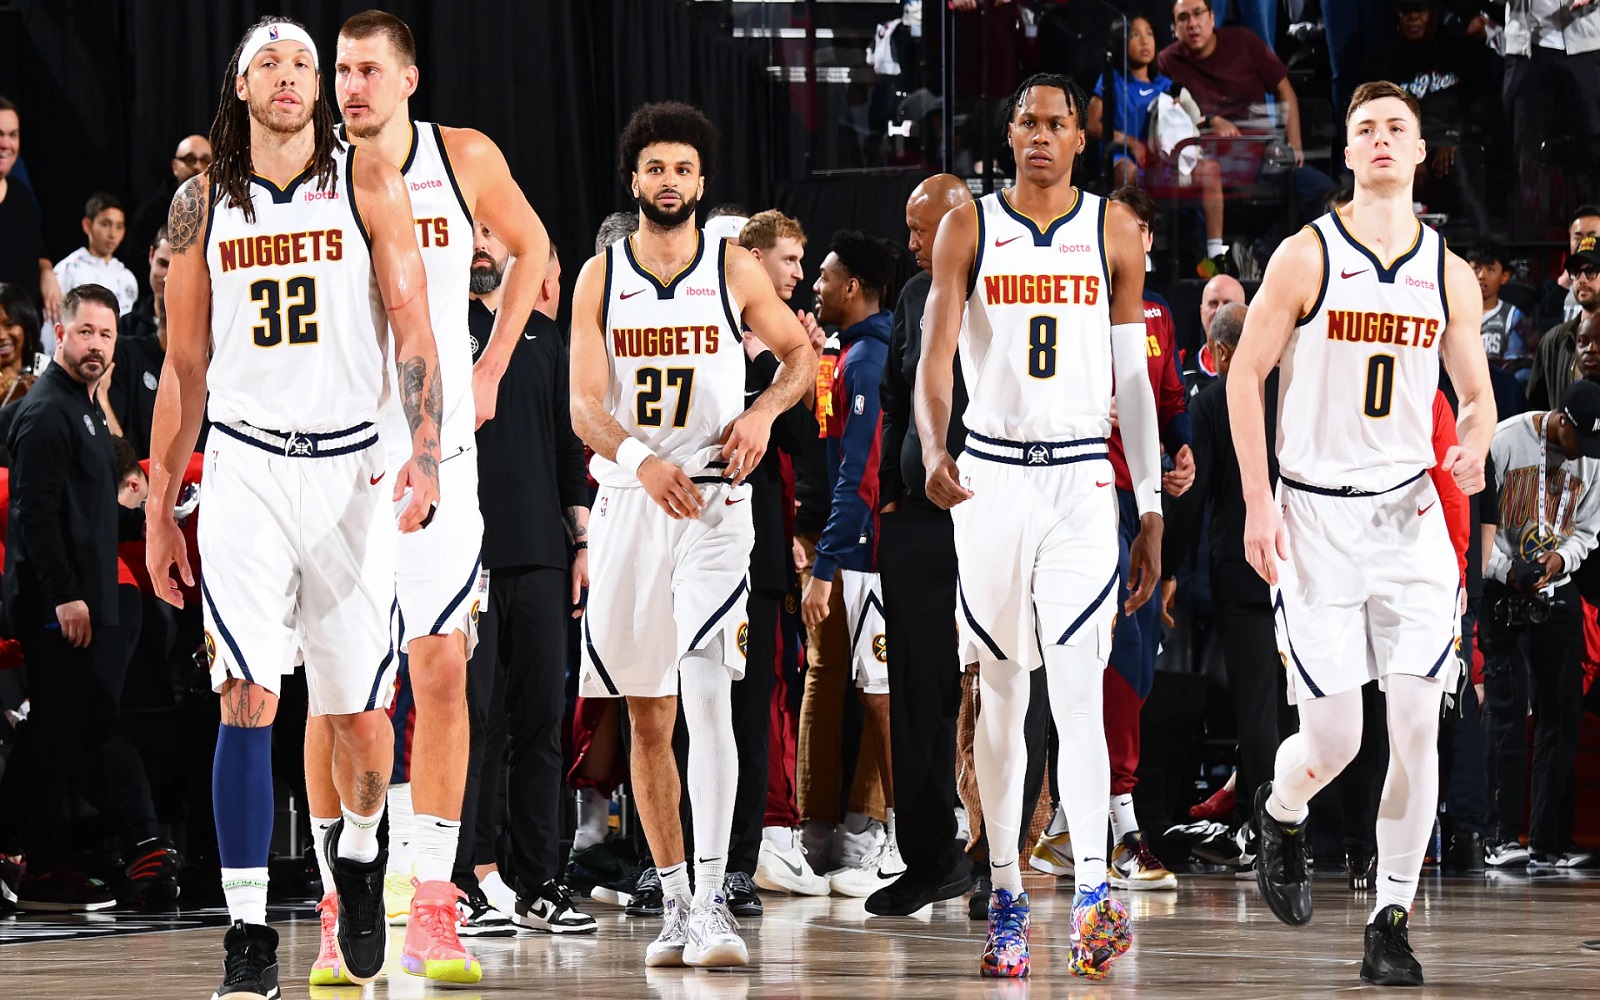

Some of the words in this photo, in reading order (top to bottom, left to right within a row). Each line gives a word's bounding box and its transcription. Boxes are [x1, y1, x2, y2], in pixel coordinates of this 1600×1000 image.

[410, 179, 443, 191] ibotta
[218, 229, 343, 273] NUGGETS
[1058, 243, 1091, 253] ibotta
[686, 286, 716, 296] ibotta
[984, 274, 1100, 306] NUGGETS
[1404, 275, 1435, 290] ibotta
[249, 274, 319, 348] 32
[1327, 309, 1439, 349] NUGGETS
[612, 324, 719, 358] NUGGETS
[1027, 313, 1058, 380] 8
[635, 366, 696, 429] 27
[1363, 352, 1396, 420] 0
